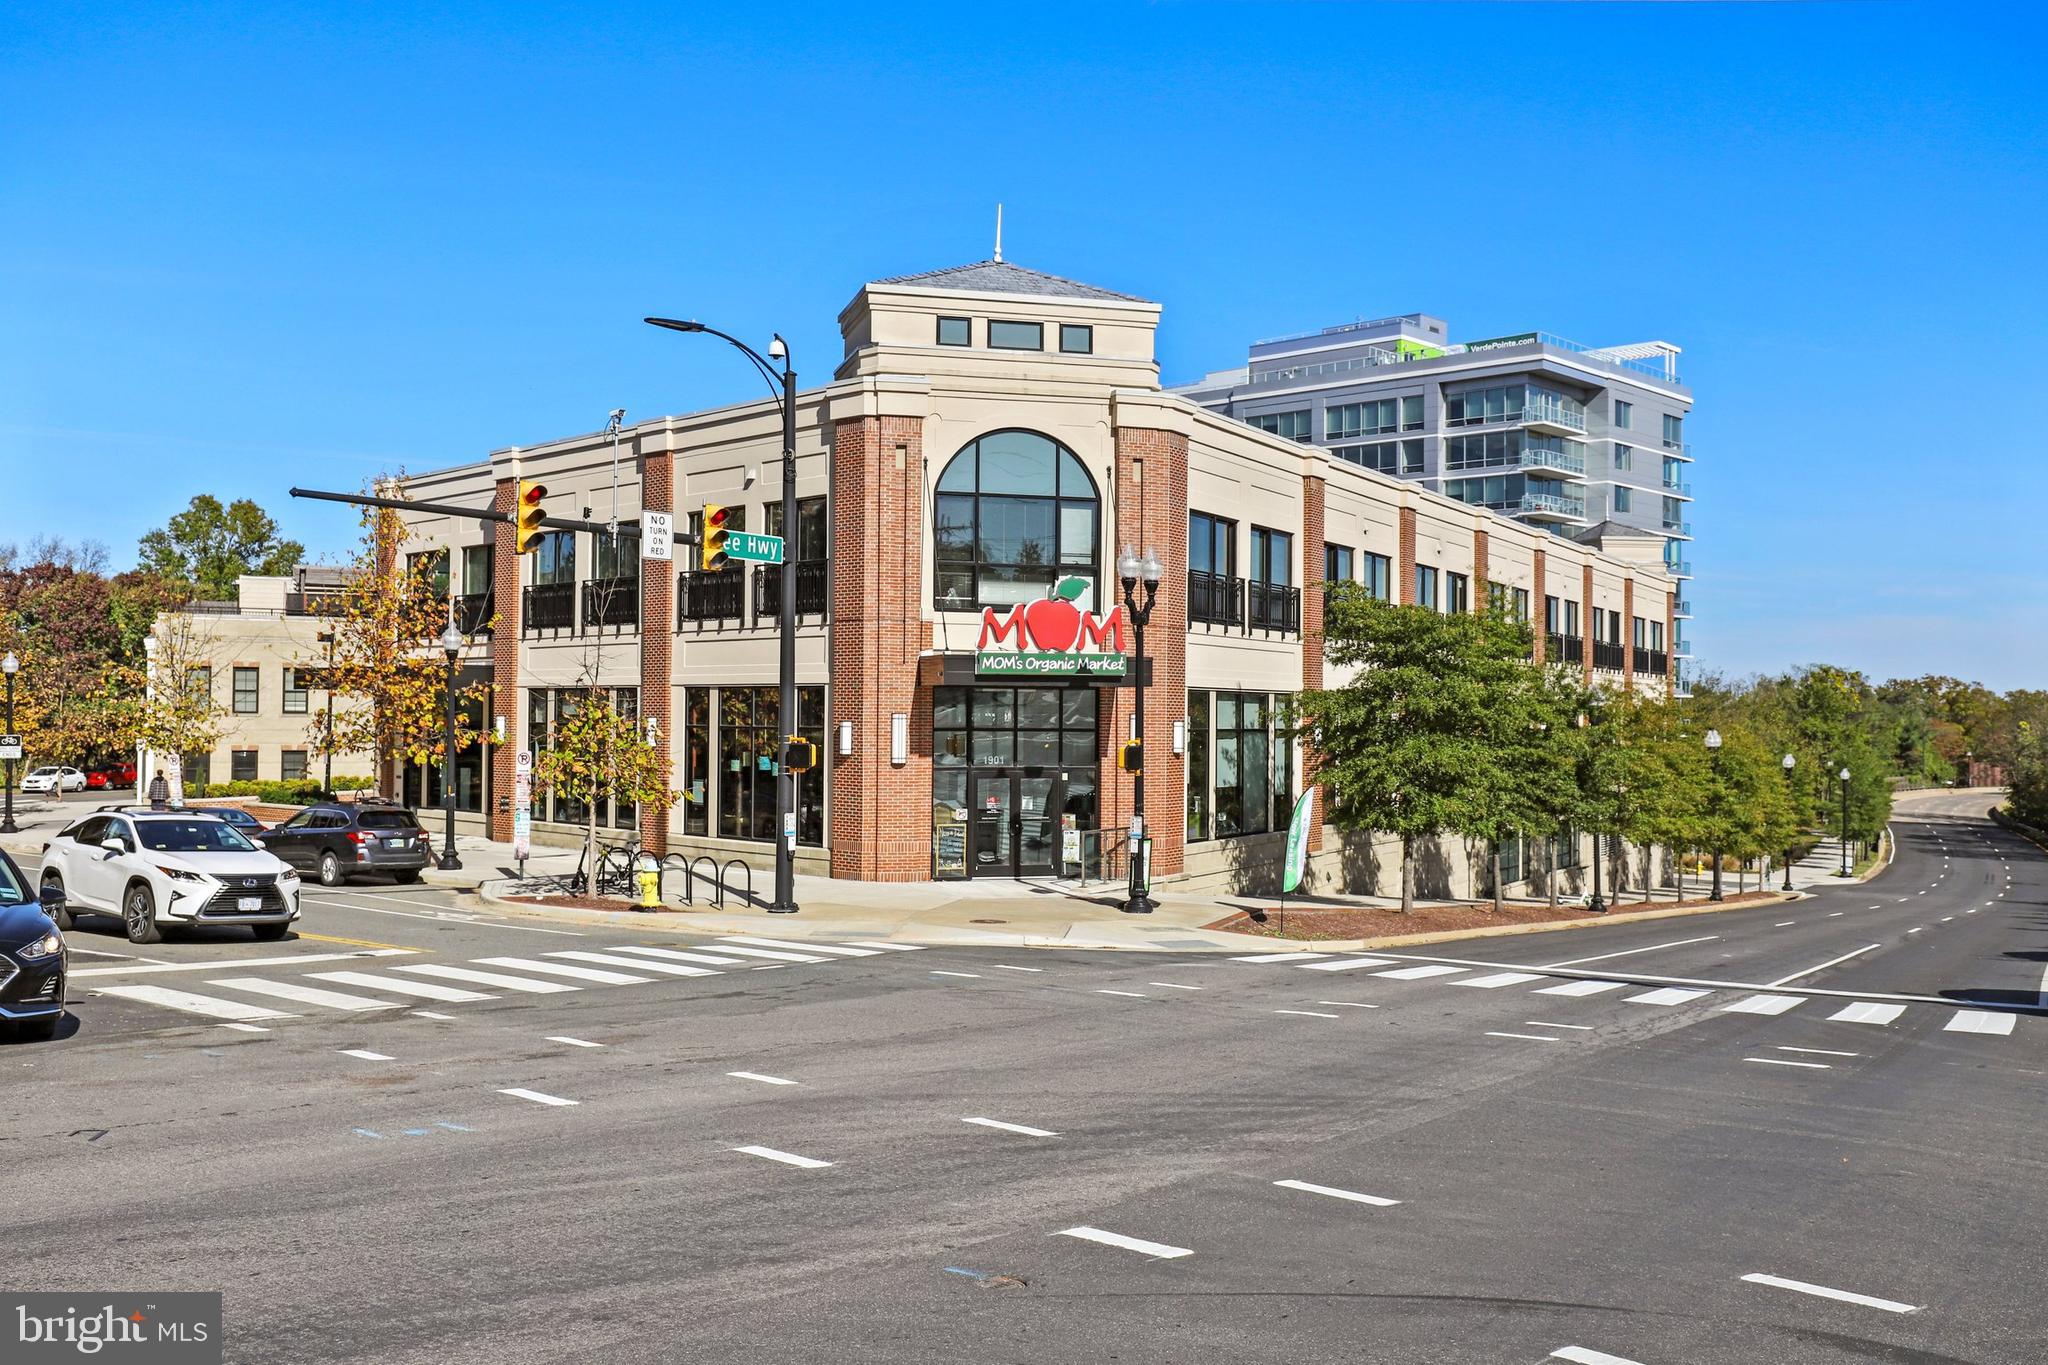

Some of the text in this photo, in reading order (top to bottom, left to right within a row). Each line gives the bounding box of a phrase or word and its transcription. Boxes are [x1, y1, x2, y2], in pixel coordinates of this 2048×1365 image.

[1470, 337, 1535, 353] VerdePointe.com
[651, 515, 666, 526] NO
[650, 527, 668, 536] TURN
[652, 537, 664, 545] ON
[650, 546, 665, 556] RED
[723, 535, 778, 560] ee Hwy
[981, 655, 1125, 673] MOM's Organic Market
[983, 755, 1004, 765] 1901
